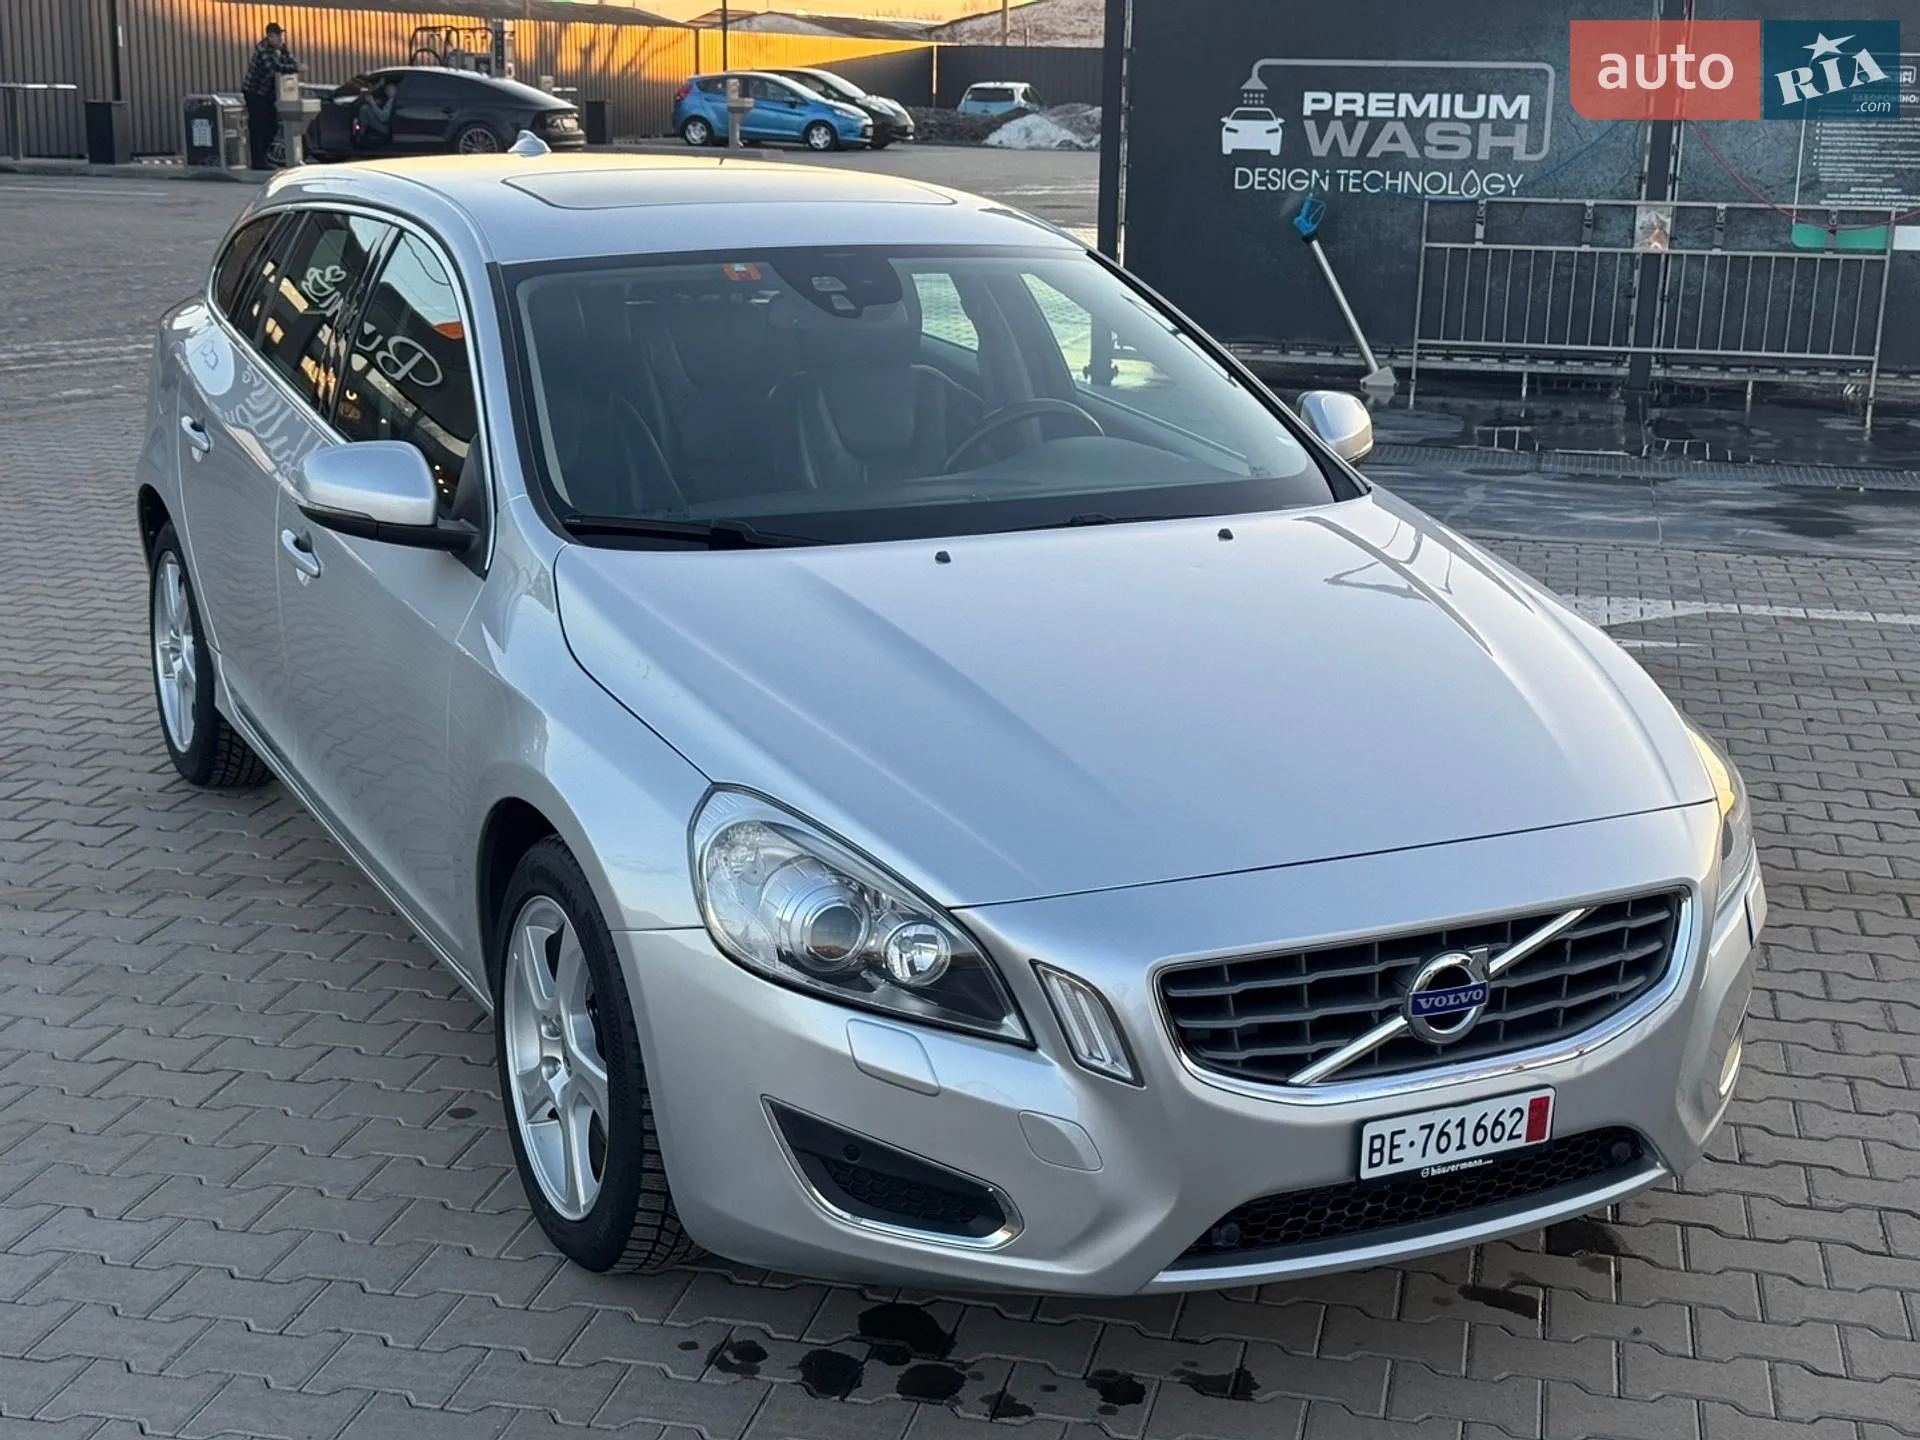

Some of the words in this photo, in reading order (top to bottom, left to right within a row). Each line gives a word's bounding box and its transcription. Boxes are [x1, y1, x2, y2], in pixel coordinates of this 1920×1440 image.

[1303, 91, 1531, 120] PREMIUM
[1303, 120, 1530, 161] WASH
[1234, 167, 1330, 193] DESIGN
[1336, 168, 1524, 198] TECHNOLOGY
[1416, 989, 1485, 1010] VOLVO
